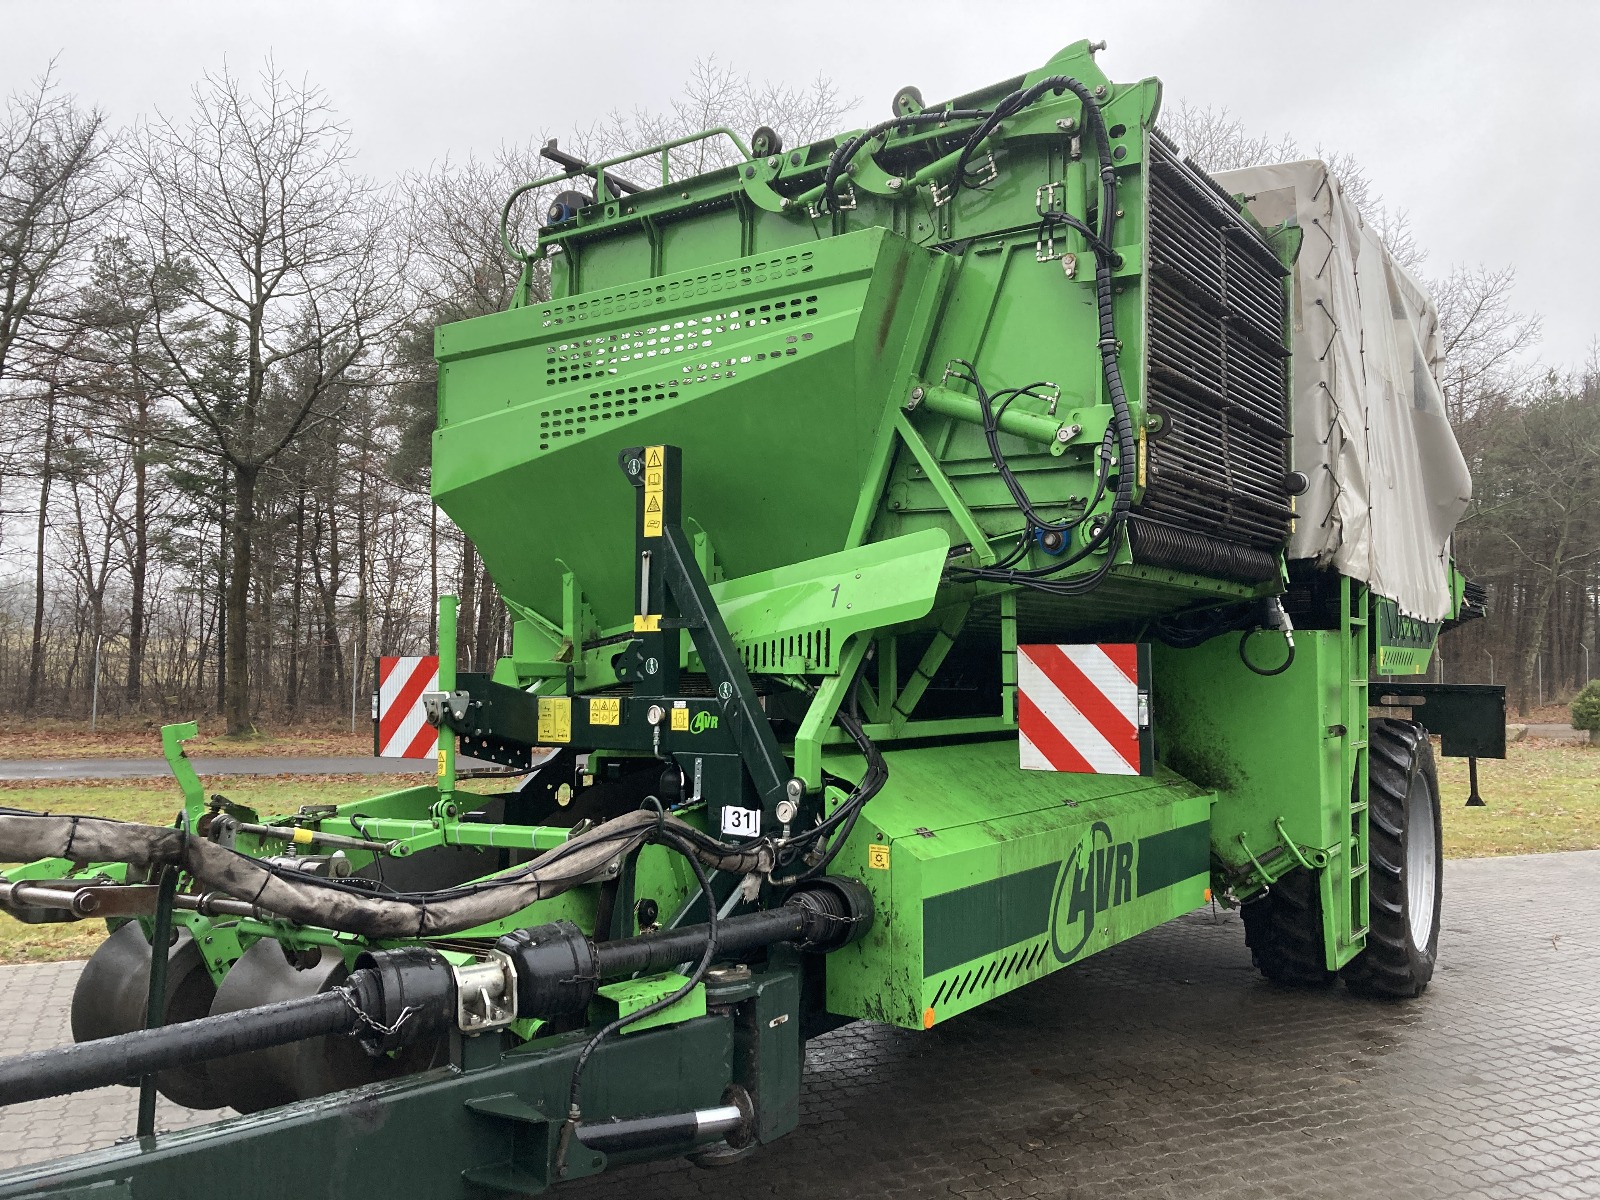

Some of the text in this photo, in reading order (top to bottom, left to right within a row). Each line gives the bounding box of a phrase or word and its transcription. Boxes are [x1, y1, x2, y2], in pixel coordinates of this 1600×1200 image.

[831, 583, 841, 608] 1
[694, 711, 719, 732] AVR
[731, 810, 751, 829] 31
[1066, 822, 1134, 934] AVR
